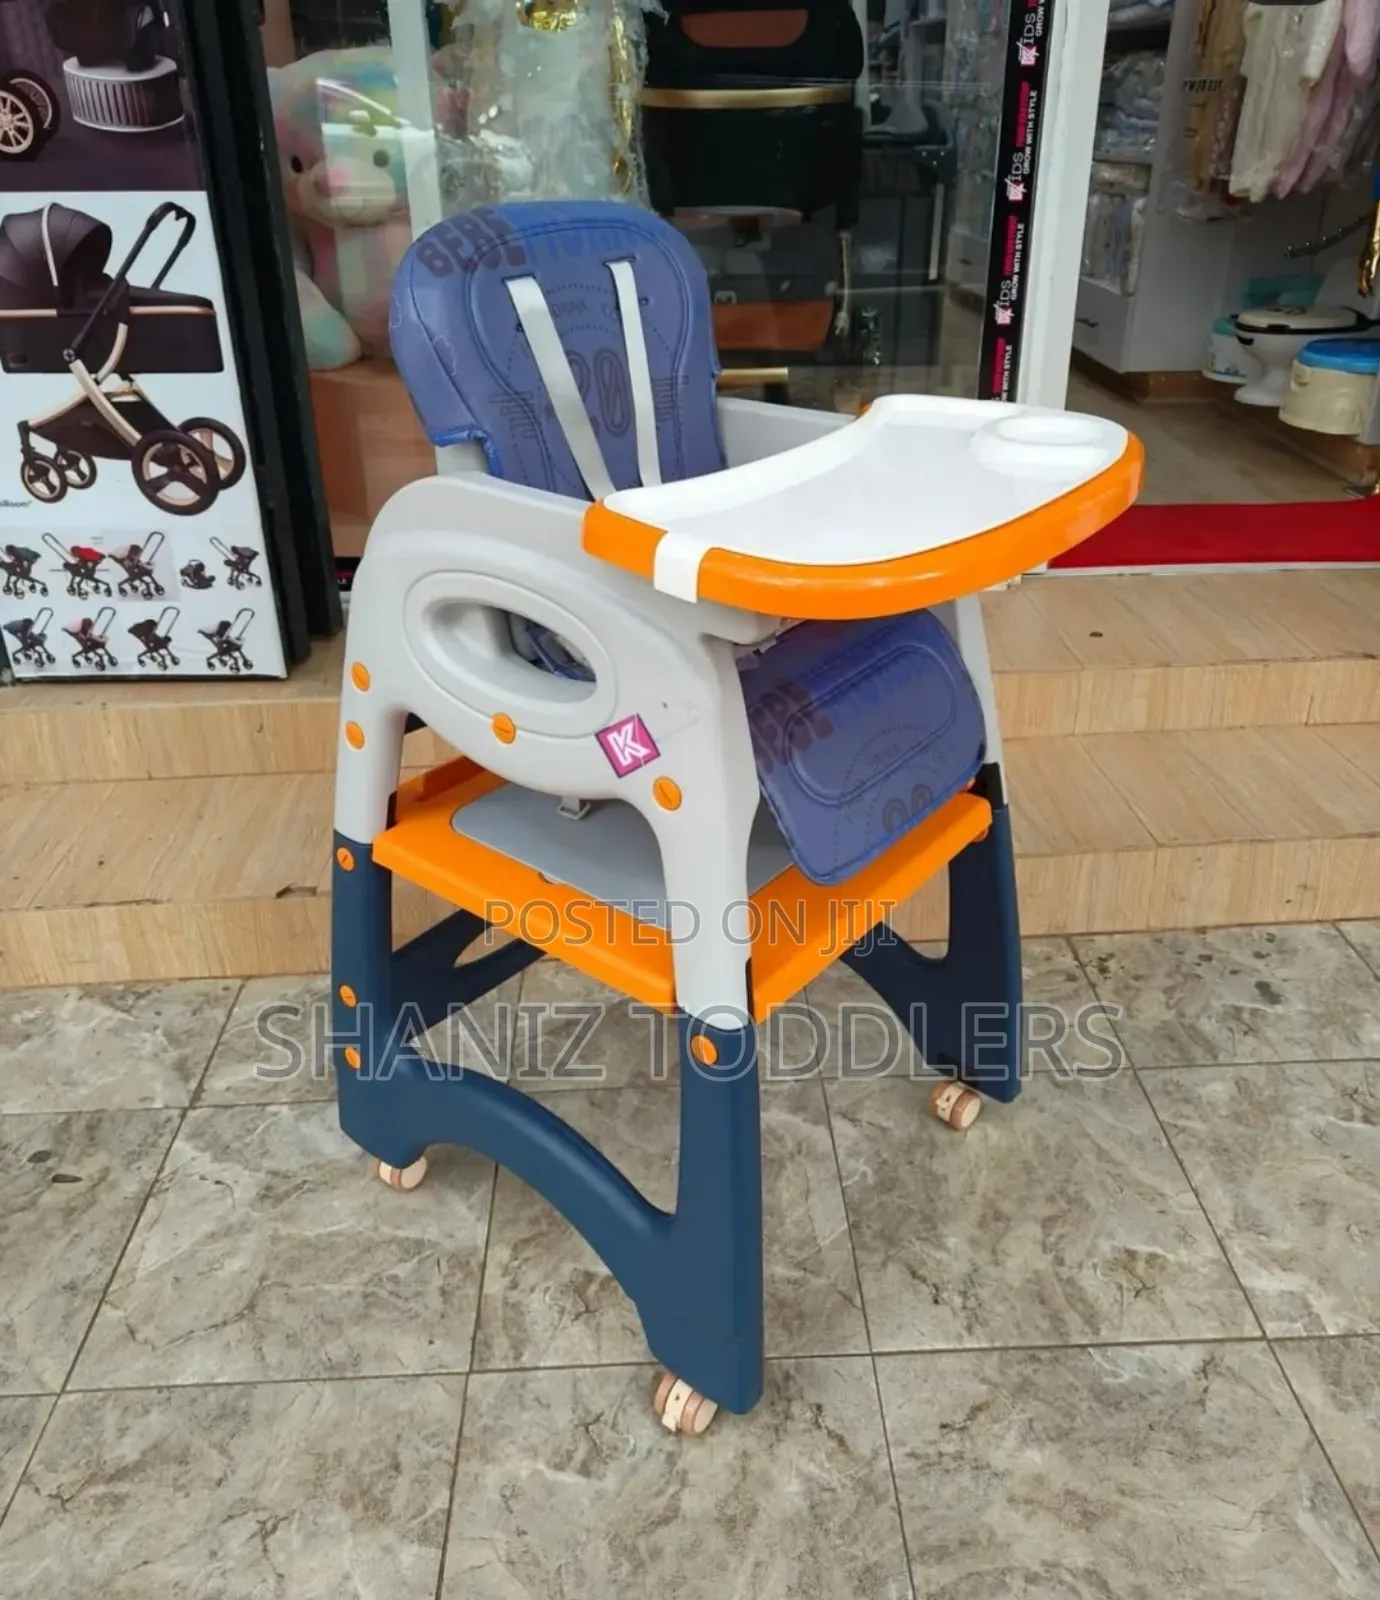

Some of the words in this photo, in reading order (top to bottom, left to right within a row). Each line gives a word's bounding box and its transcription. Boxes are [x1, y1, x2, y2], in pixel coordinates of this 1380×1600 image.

[1028, 89, 1037, 120] STYLE
[1025, 121, 1034, 145] WITH
[1023, 146, 1032, 175] GROW
[1016, 222, 1025, 250] STYLE
[1013, 251, 1022, 273] WITH
[1010, 274, 1019, 301] GROW
[1004, 344, 1013, 370] STYLE
